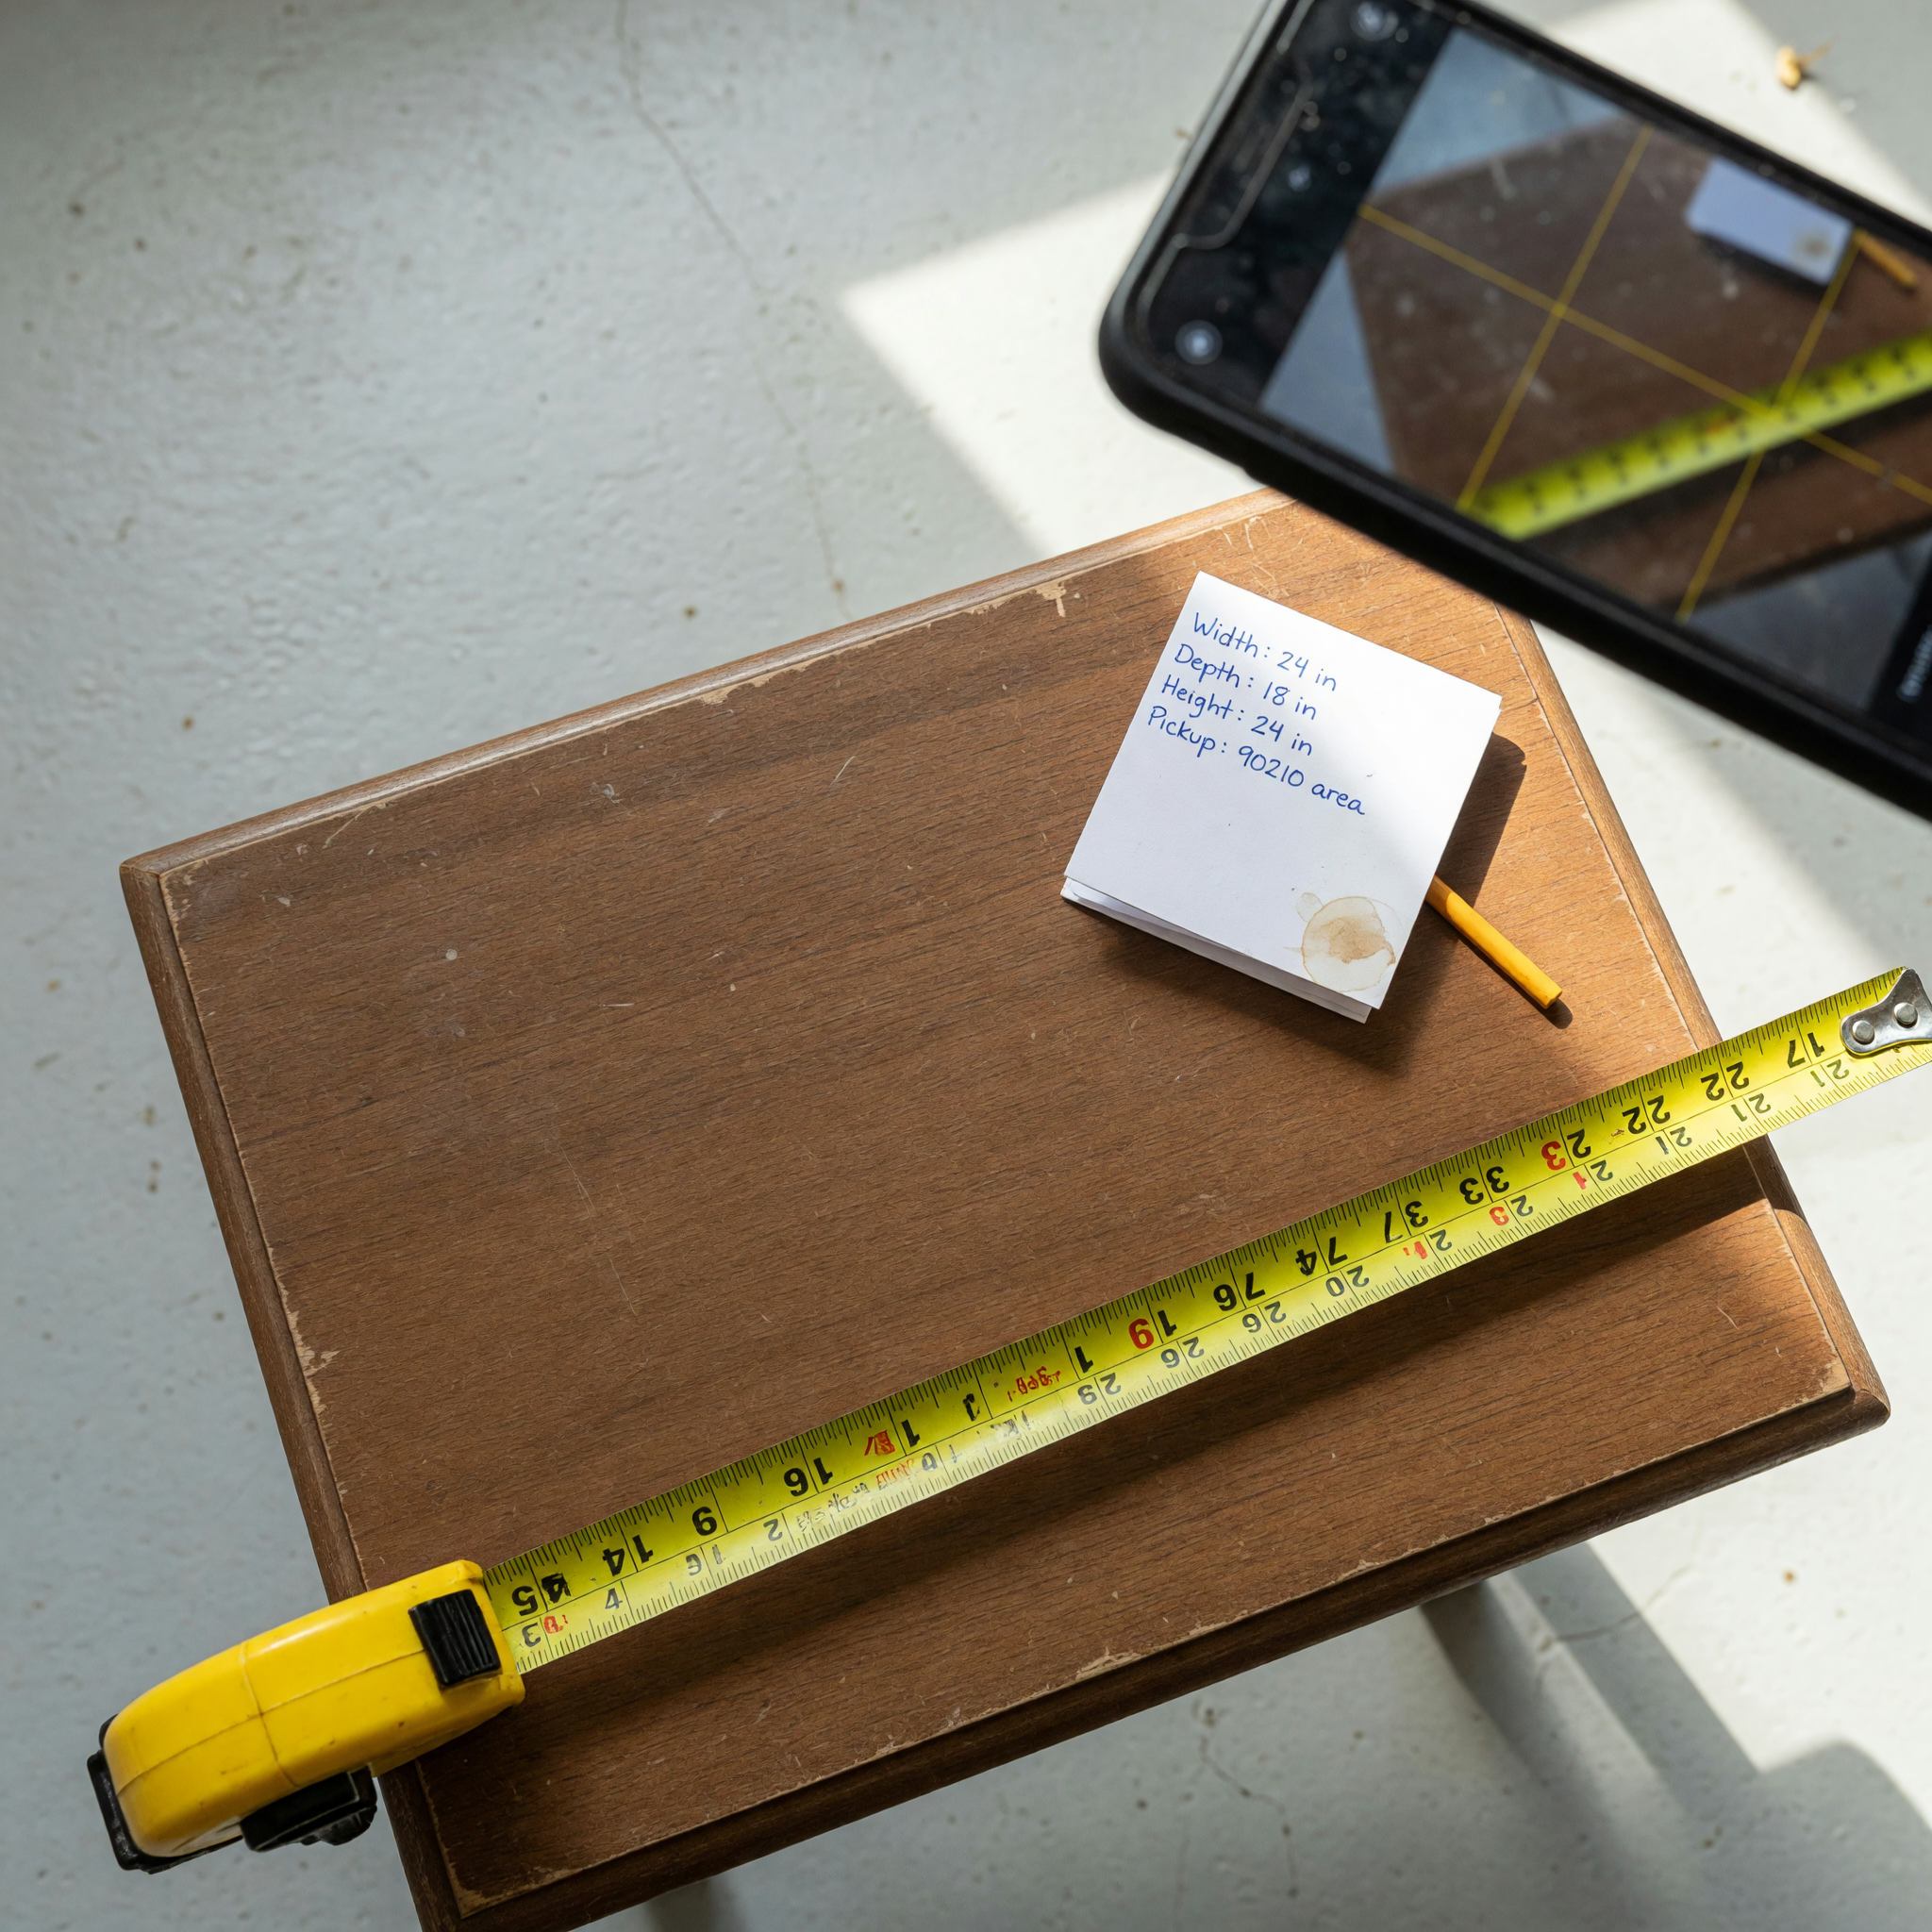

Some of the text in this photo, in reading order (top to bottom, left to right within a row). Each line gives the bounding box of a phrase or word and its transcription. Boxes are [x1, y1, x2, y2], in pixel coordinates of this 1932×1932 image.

[1193, 611, 1338, 691] Width: 24 in
[1174, 642, 1318, 721] Depth: 18 in
[1160, 674, 1313, 757] Height: 24 in
[1147, 705, 1366, 816] Pickup: 90210 area
[1787, 1032, 1825, 1069] 17
[1700, 1061, 1750, 1101] 22
[1809, 1058, 1850, 1088] 21
[1622, 1095, 1671, 1135] 22
[1730, 1092, 1772, 1123] 21
[1541, 1129, 1591, 1171] 23
[1655, 1126, 1692, 1155] 21
[1459, 1166, 1509, 1206] 33
[1295, 1237, 1348, 1276] 74
[1213, 1272, 1266, 1312] 76
[1325, 1265, 1370, 1297] 20
[1128, 1310, 1177, 1350] 19
[1241, 1301, 1287, 1334] 26
[1160, 1336, 1205, 1369] 26
[783, 1457, 833, 1497] 16
[602, 1535, 654, 1576] 14
